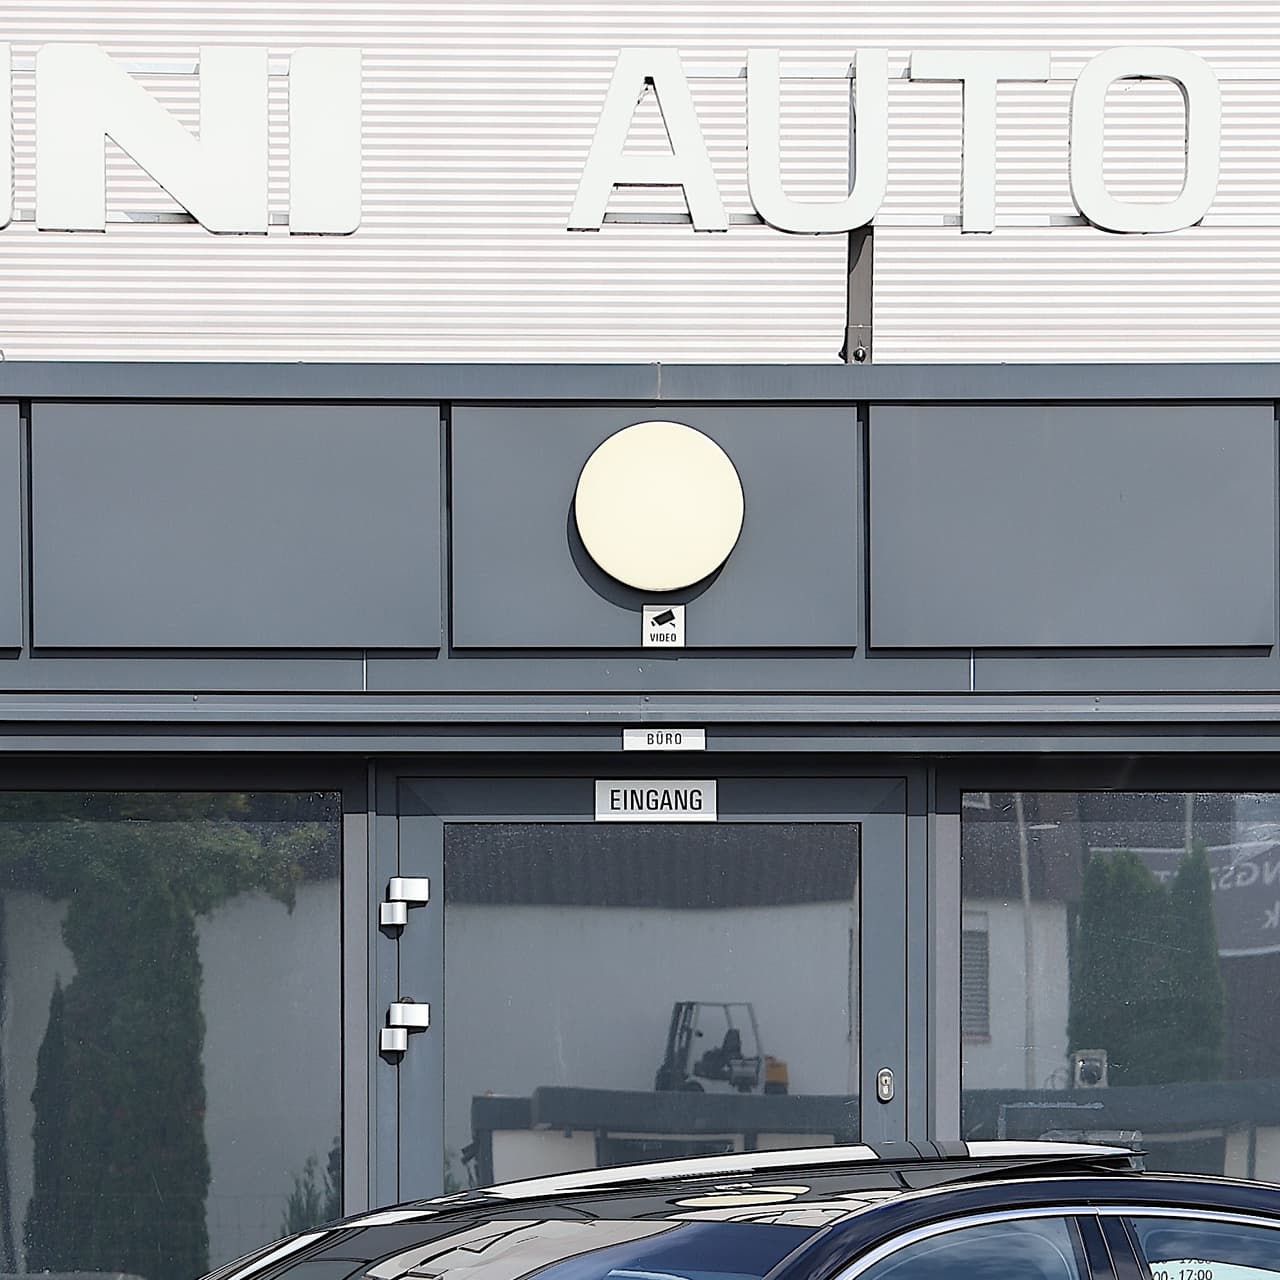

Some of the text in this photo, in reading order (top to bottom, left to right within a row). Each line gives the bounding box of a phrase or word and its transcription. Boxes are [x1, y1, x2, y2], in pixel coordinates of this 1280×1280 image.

[567, 45, 1221, 236] AUTO
[650, 633, 677, 643] VIDEO
[647, 731, 682, 745] BÜRO
[610, 788, 703, 811] EINGANG
